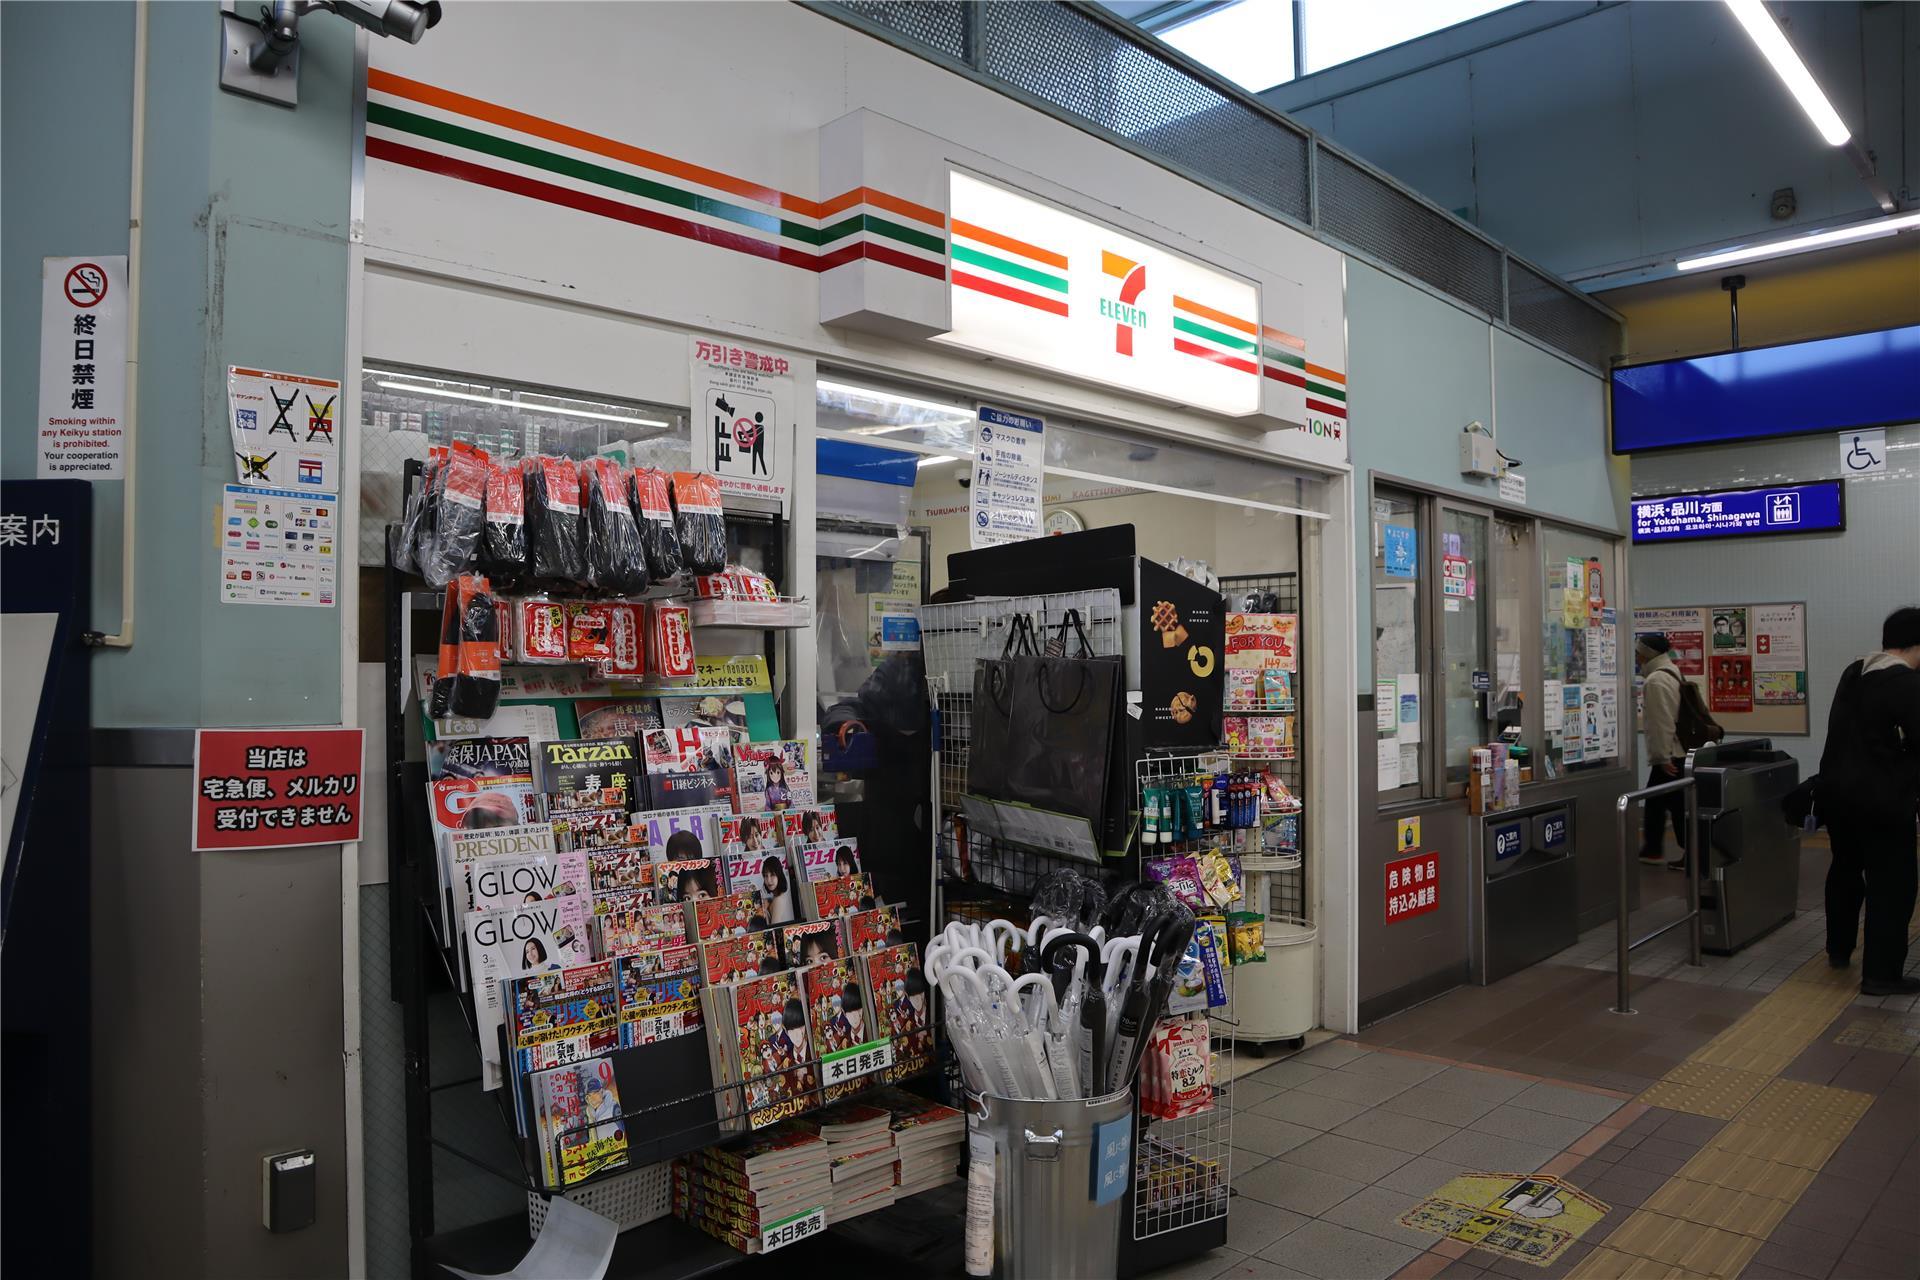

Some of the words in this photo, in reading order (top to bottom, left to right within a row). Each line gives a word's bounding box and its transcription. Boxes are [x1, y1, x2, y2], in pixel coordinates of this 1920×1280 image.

[1101, 249, 1146, 357] 7
[71, 314, 97, 411] 終日禁煙
[693, 340, 790, 375] 万引き警戒中
[49, 417, 87, 427] Smoking
[89, 417, 116, 425] within
[42, 430, 57, 438] any
[60, 429, 90, 438] Keikyu
[92, 428, 122, 437] station
[63, 440, 110, 449] prohibited.
[44, 452, 64, 460] Your
[66, 451, 119, 461] cooperation
[49, 463, 57, 471] is
[59, 462, 113, 473] appreciated.
[994, 470, 1038, 484] ソーシャルディスタンス
[1637, 501, 1699, 519] 横浜・品川
[1701, 501, 1723, 513] 方面
[1638, 519, 1652, 527] for
[1653, 515, 1704, 527] Yokohama,
[1707, 511, 1761, 523] Shinagawa
[0, 513, 60, 547] 案内
[1231, 637, 1257, 649] FOR
[1259, 635, 1284, 648] YOU
[665, 708, 709, 717] セブンミール
[248, 747, 307, 769] 当店は
[446, 744, 529, 765] 森保JAPAN
[547, 743, 633, 764] Tarzan
[203, 775, 357, 799] 宅急便、メルカリ
[584, 773, 602, 792] 寿
[611, 771, 628, 790] 座
[671, 776, 716, 791] 日経ビジネス
[217, 805, 351, 830] 受付できません
[649, 813, 718, 847] AER
[455, 834, 549, 859] PRESIDENT
[478, 864, 558, 897] GLOW
[1388, 860, 1436, 890] 危険物品
[1388, 886, 1436, 916] 持込み厳禁
[474, 908, 558, 946] GLOW
[482, 954, 489, 964] 3
[599, 1061, 612, 1088] 9
[831, 1049, 886, 1079] 本日発売
[1182, 1076, 1196, 1088] 8.2
[767, 1214, 821, 1247] 本日発売
